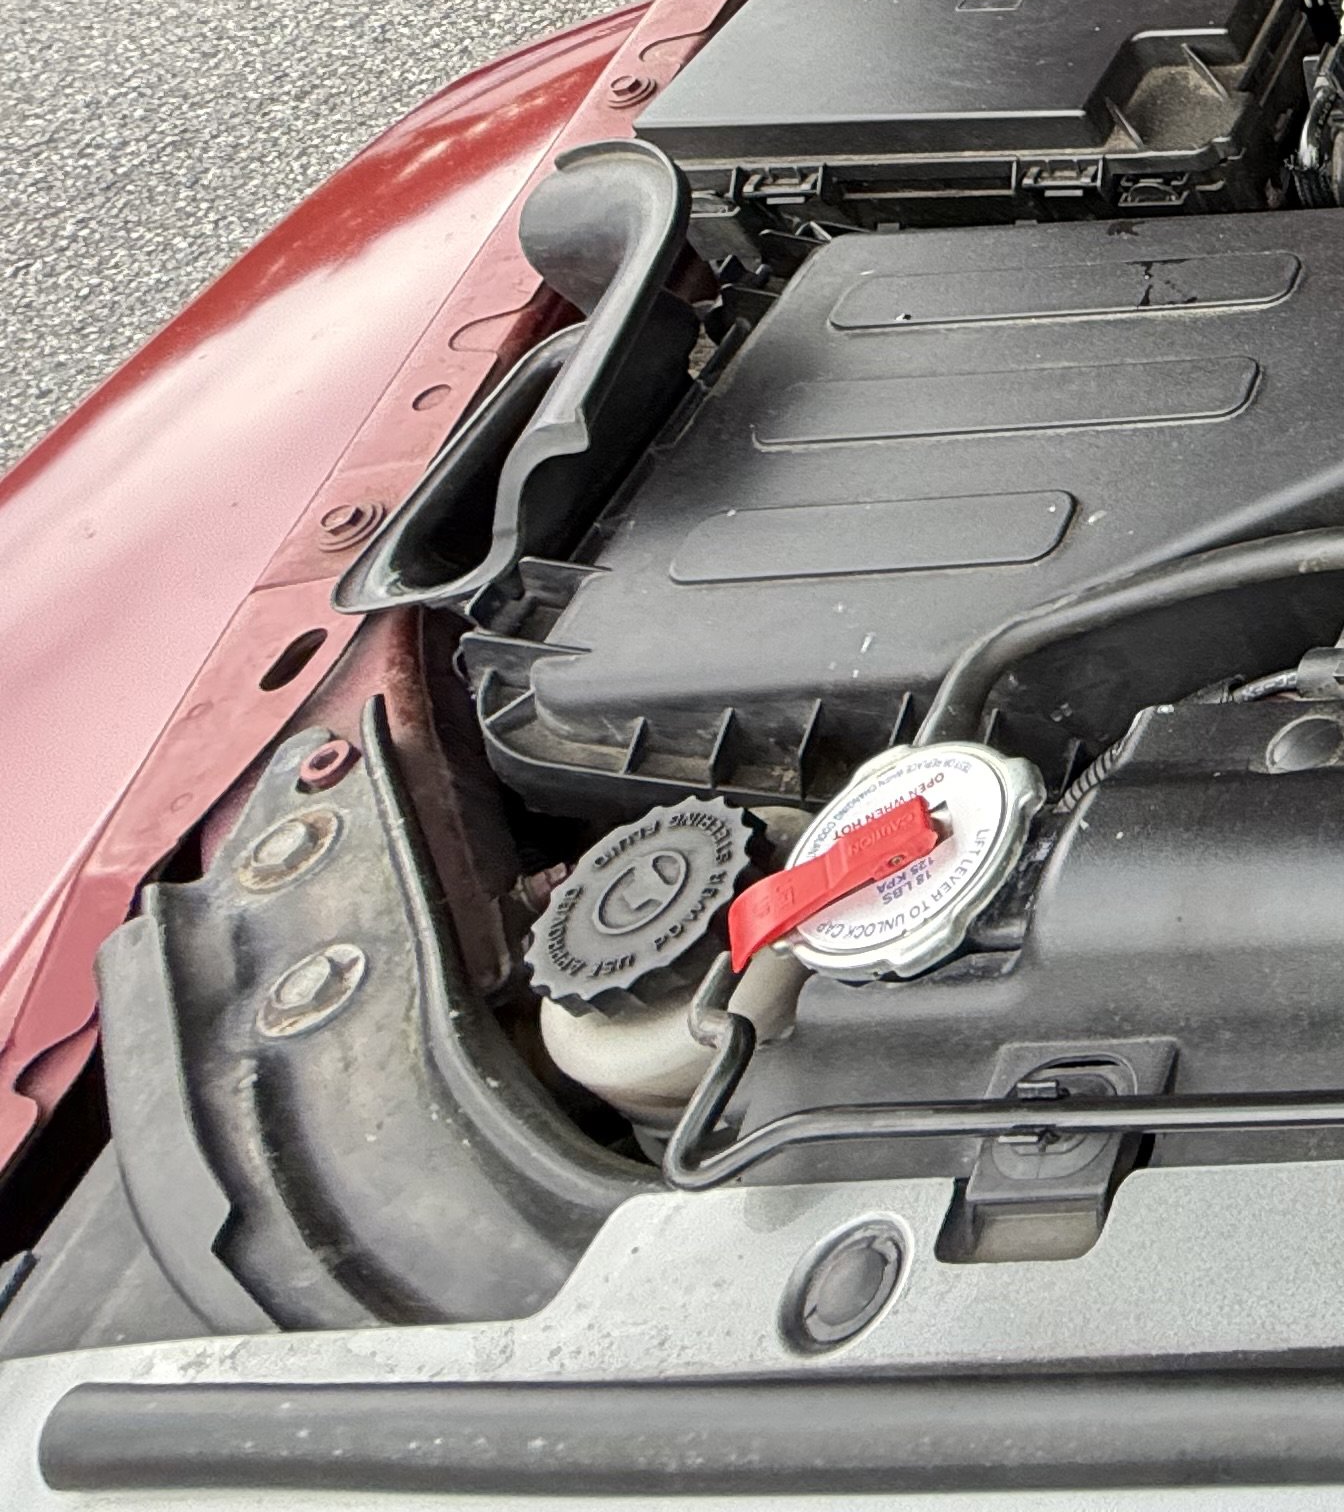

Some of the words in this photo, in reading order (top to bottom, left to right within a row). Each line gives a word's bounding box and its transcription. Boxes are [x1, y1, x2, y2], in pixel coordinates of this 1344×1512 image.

[909, 772, 945, 797] OPEN
[836, 784, 877, 817] CHANGING
[669, 811, 735, 867] STEERING
[831, 815, 870, 841] HOT
[593, 819, 662, 869] FLUID
[973, 828, 990, 855] LIFT
[876, 872, 909, 894] KPA
[915, 869, 932, 886] 18
[931, 856, 974, 901] LEVER
[881, 881, 912, 905] LBS
[654, 870, 727, 951] POWER
[909, 898, 930, 918] TO
[816, 922, 845, 938] CAP
[844, 913, 905, 940] UNLOCK
[590, 952, 637, 978] USE
